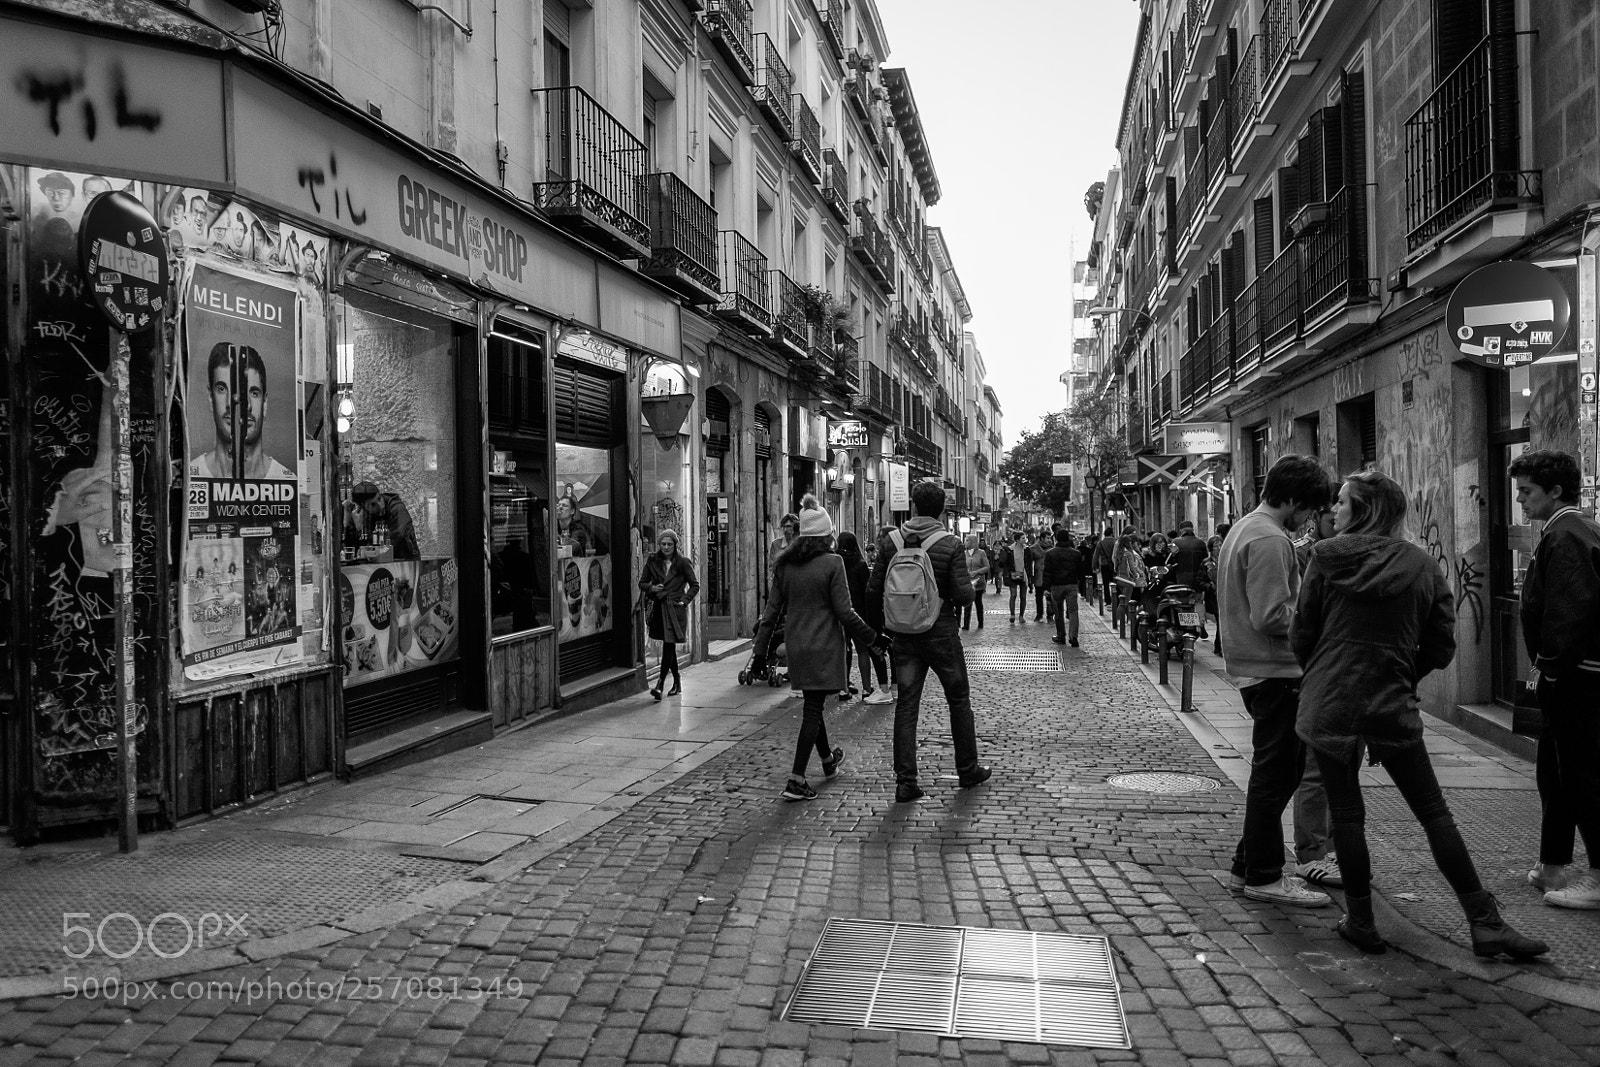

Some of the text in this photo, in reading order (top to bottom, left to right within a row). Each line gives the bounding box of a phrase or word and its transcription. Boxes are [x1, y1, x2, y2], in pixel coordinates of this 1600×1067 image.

[398, 174, 528, 284] GREEK AND SHOP
[194, 284, 283, 323] MELENDI
[1530, 332, 1553, 344] HVK
[189, 490, 207, 505] 28
[213, 482, 295, 502] MADRID
[252, 504, 291, 516] CENTER
[194, 653, 202, 663] ES
[259, 636, 265, 645] TE
